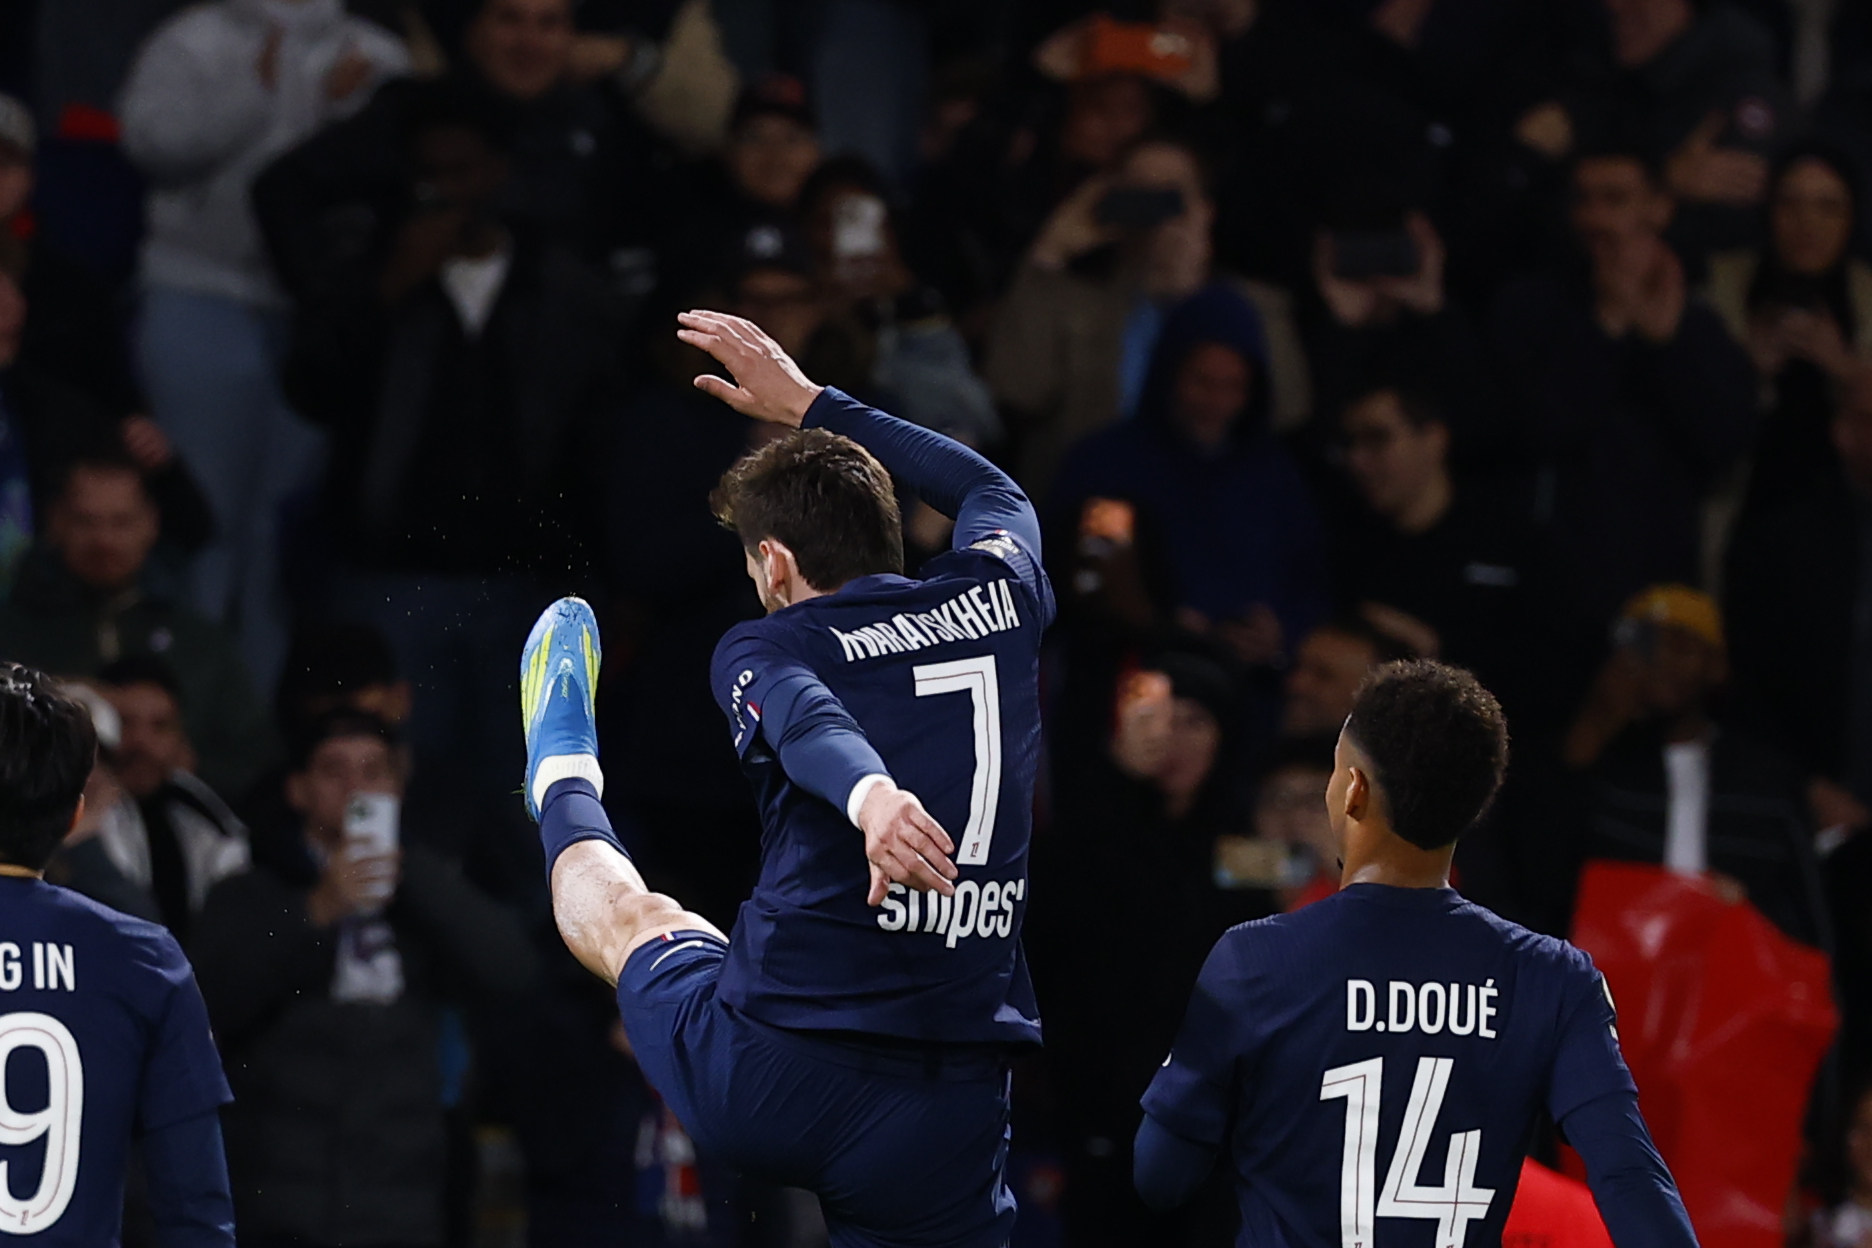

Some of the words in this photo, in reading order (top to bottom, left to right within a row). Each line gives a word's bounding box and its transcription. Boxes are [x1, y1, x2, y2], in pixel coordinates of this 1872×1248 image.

[912, 653, 1003, 866] 7
[31, 942, 77, 993] IN
[1346, 978, 1499, 1040] D.DOUÉ
